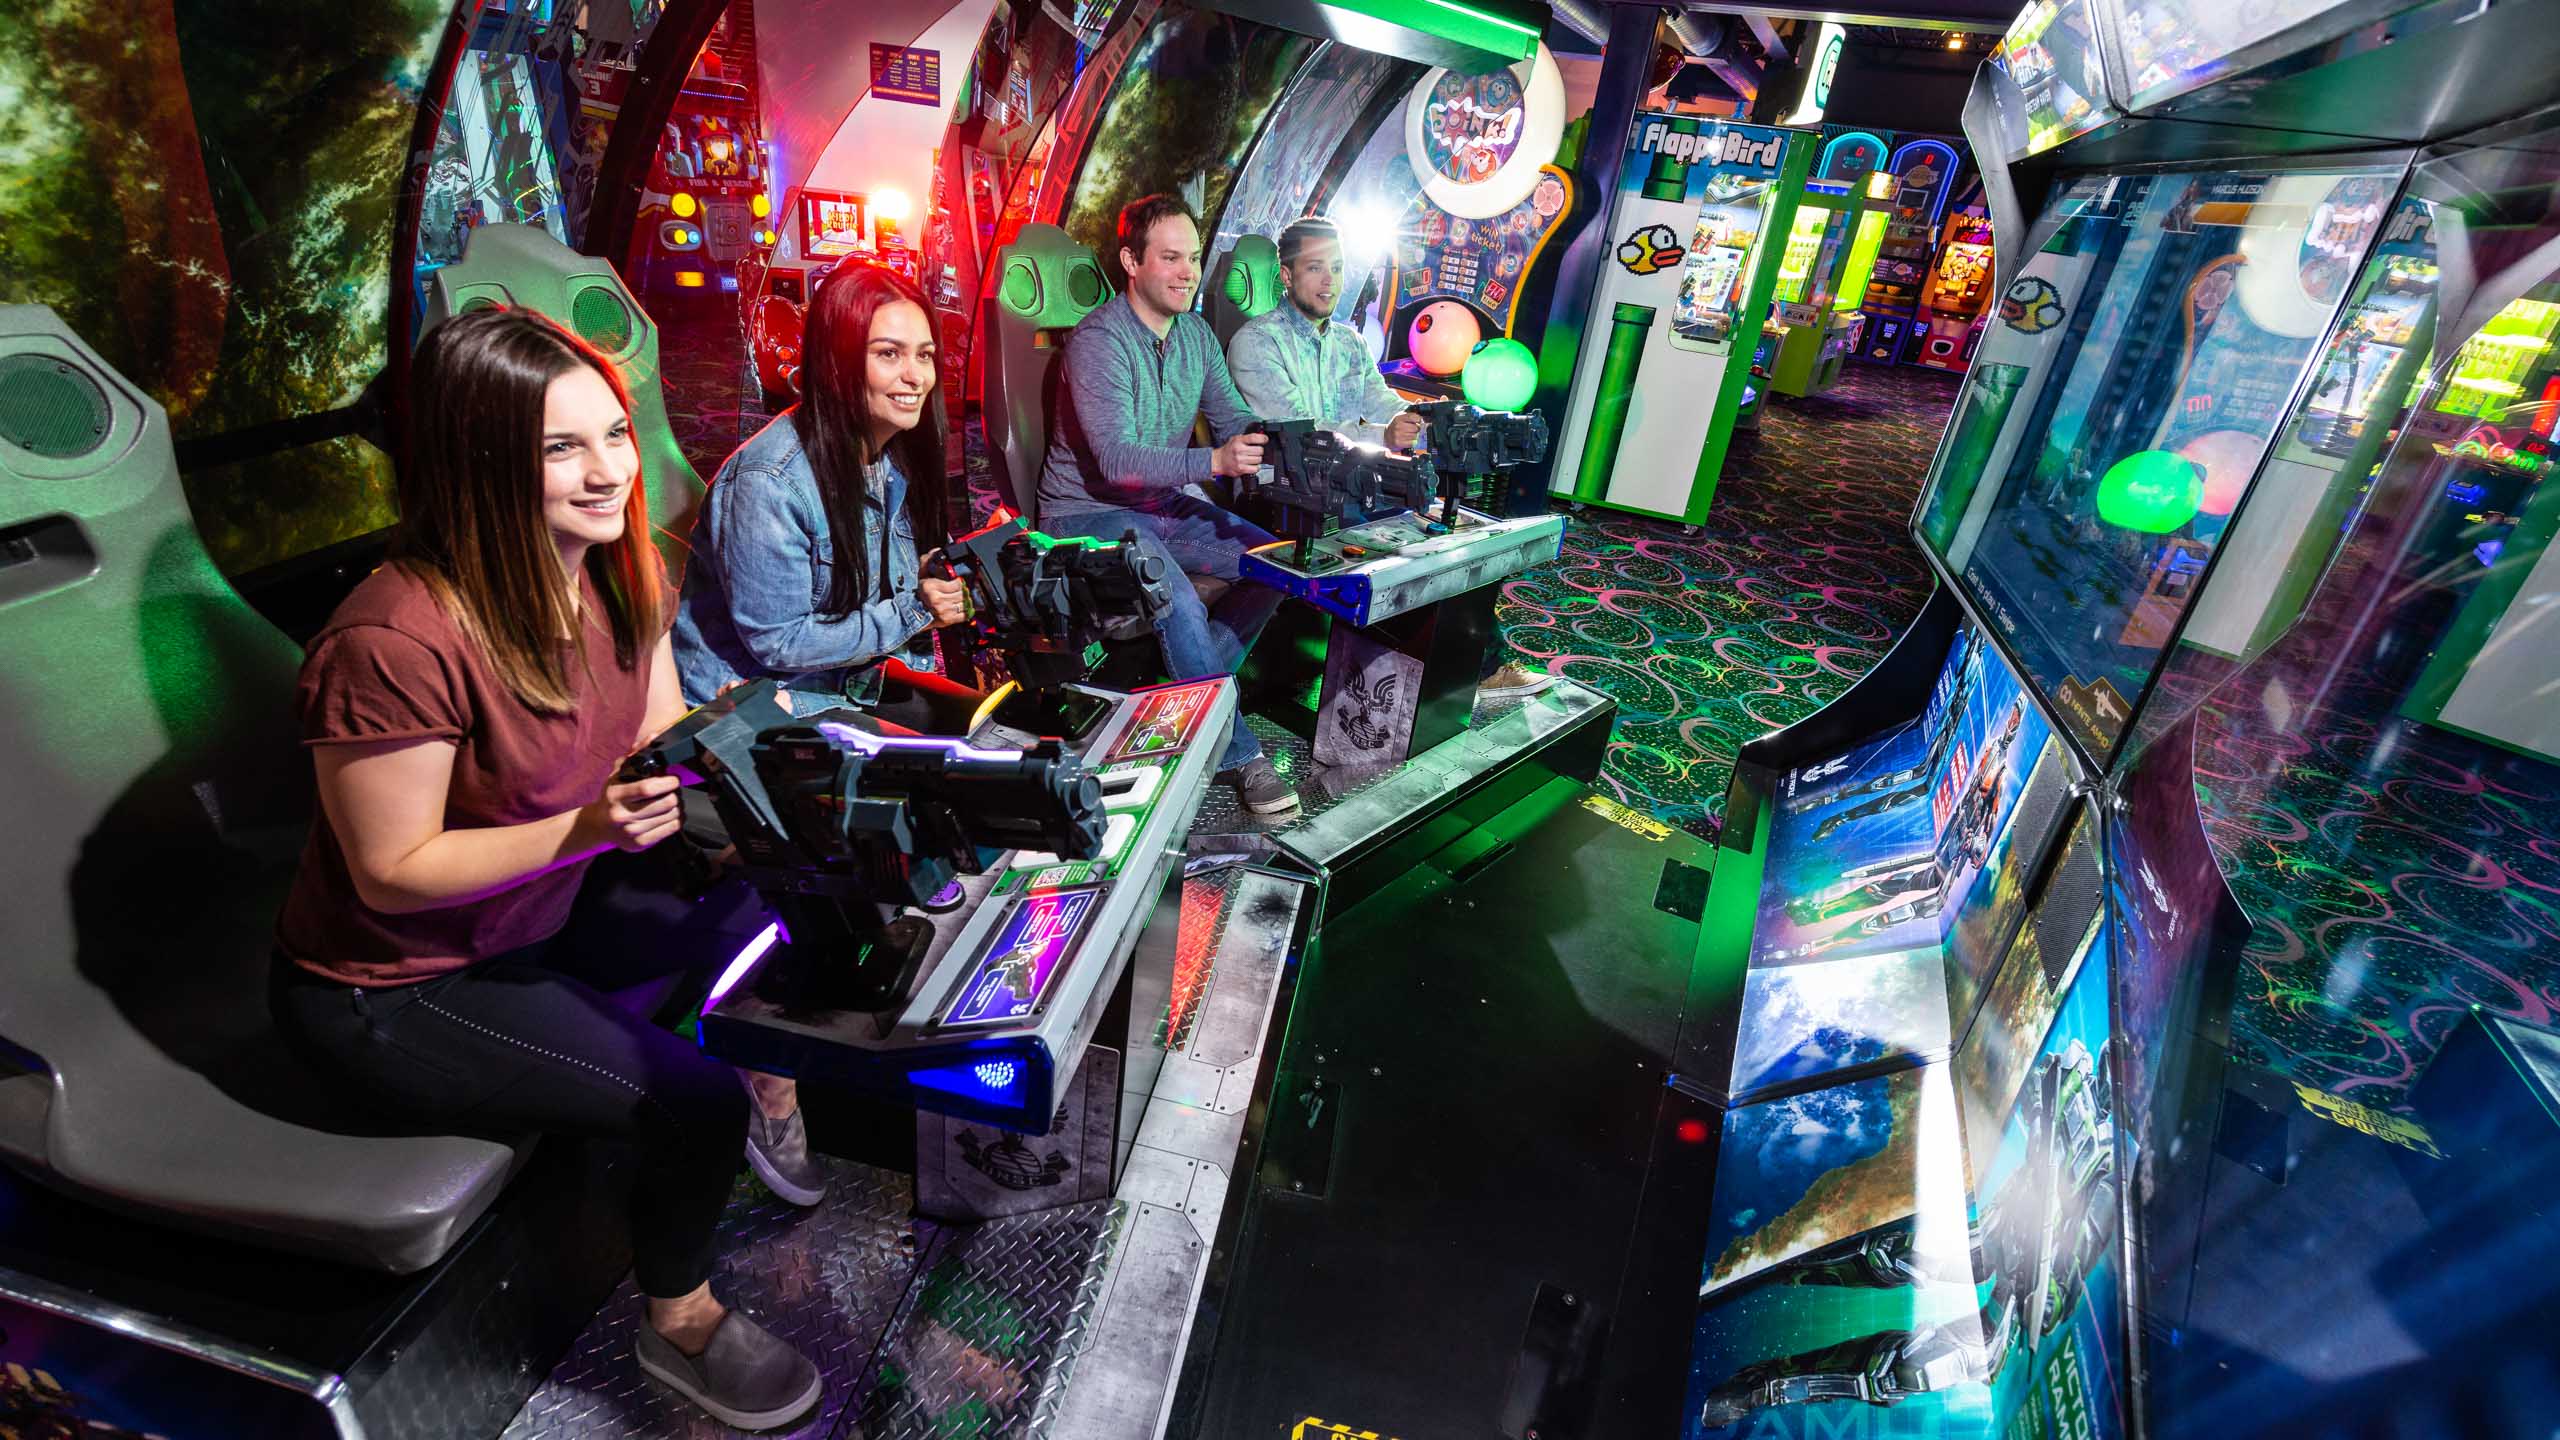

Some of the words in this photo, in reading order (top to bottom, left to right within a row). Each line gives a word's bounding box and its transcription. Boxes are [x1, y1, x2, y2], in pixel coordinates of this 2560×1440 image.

[1967, 567, 1979, 587] Cost
[1983, 590, 1996, 610] play
[1998, 607, 2015, 634] Swipe
[2063, 1335, 2090, 1440] VICTO
